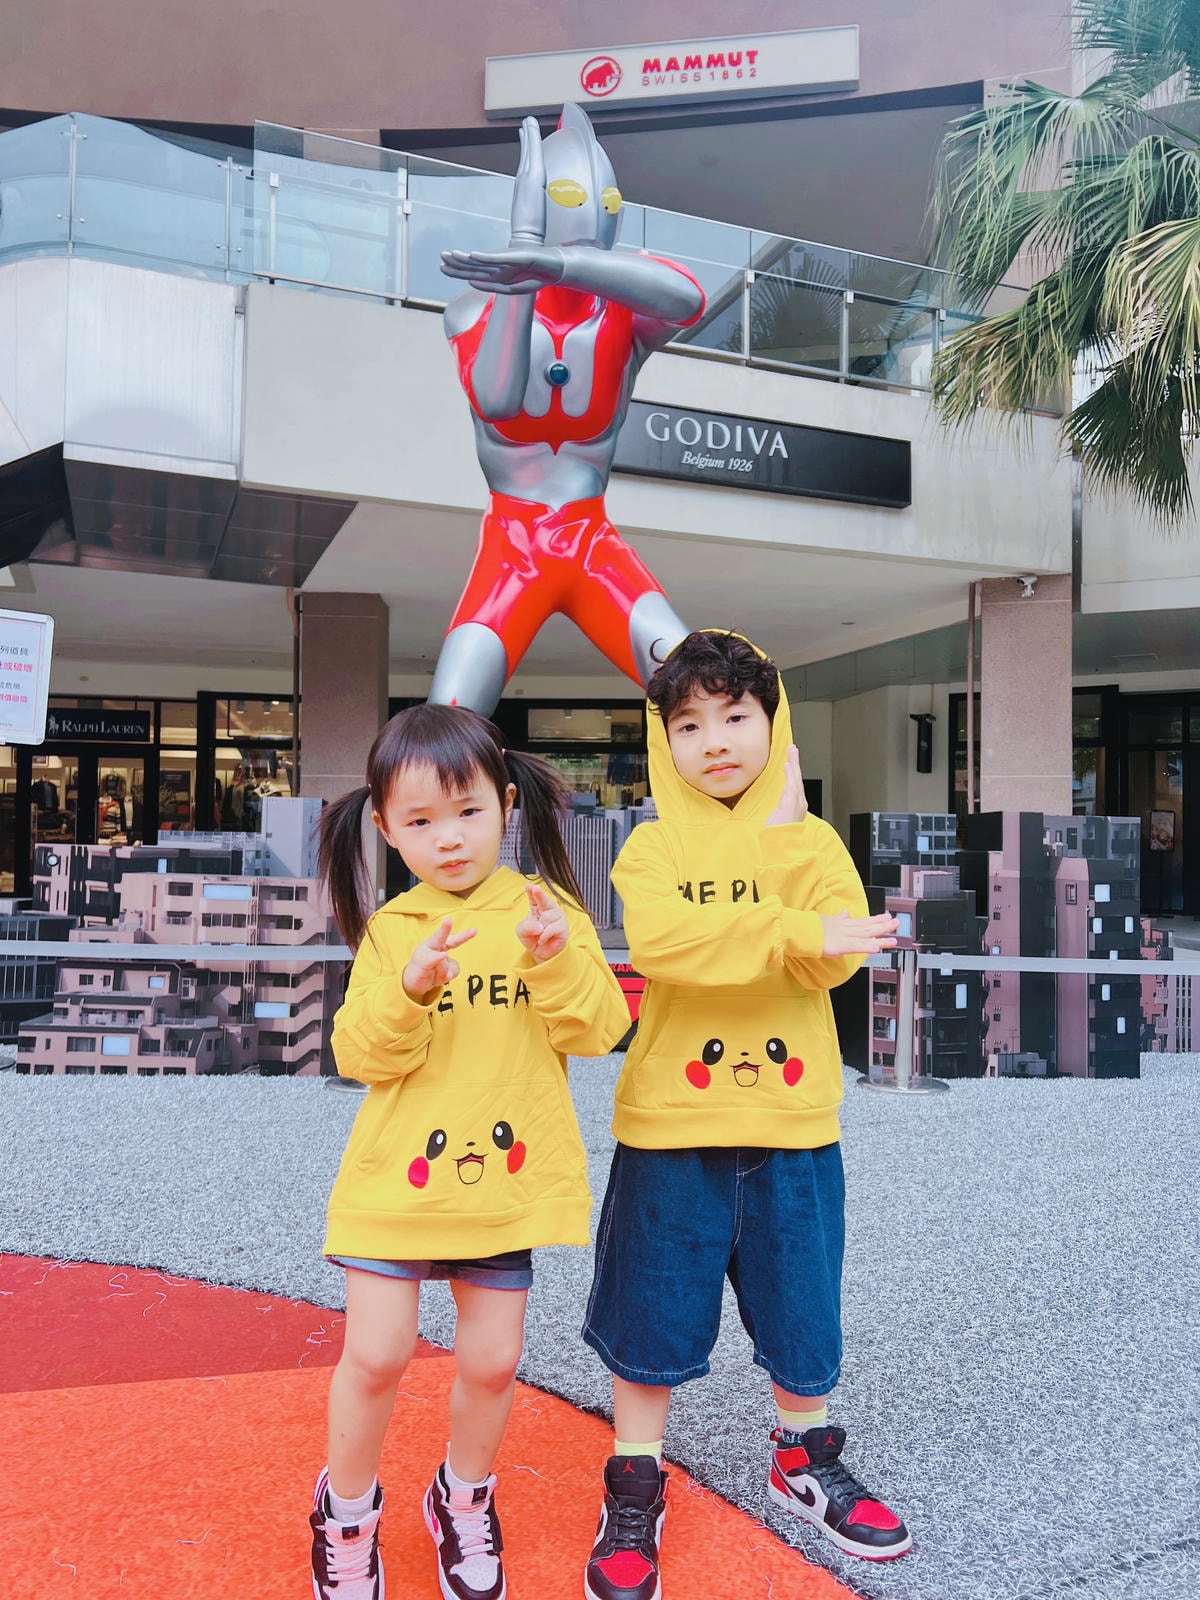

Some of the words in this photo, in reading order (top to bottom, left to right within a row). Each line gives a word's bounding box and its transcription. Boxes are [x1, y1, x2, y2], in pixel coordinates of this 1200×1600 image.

[642, 50, 758, 74] MAMMUT
[642, 72, 701, 86] SWISS
[710, 67, 757, 81] 1862
[645, 412, 789, 459] GODIVA
[681, 450, 725, 470] Belgium
[727, 457, 754, 472] 1926
[62, 719, 99, 734] RALPH
[101, 720, 145, 735] LAUREN
